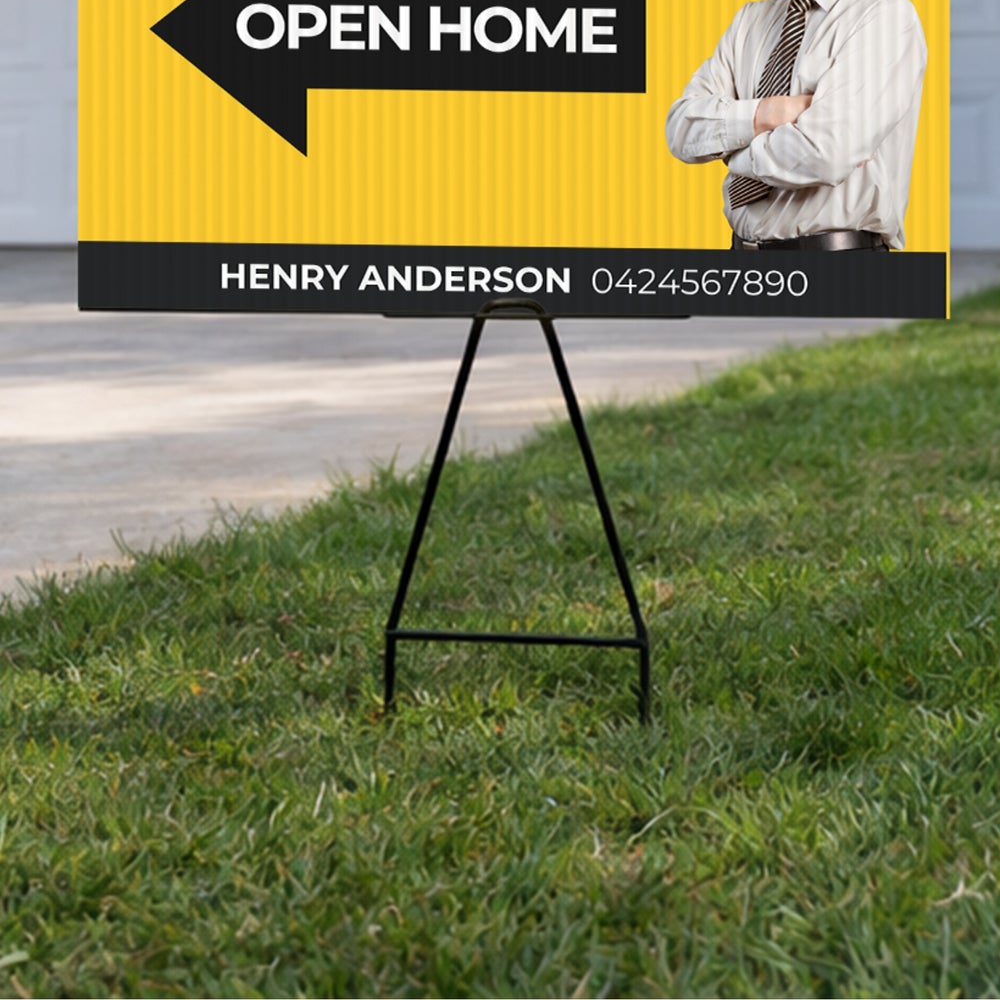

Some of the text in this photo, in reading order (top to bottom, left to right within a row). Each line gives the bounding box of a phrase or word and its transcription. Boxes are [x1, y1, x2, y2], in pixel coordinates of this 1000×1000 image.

[236, 3, 617, 54] OPEN HOME
[221, 263, 809, 297] HENRY ANDERSON 0424567890
